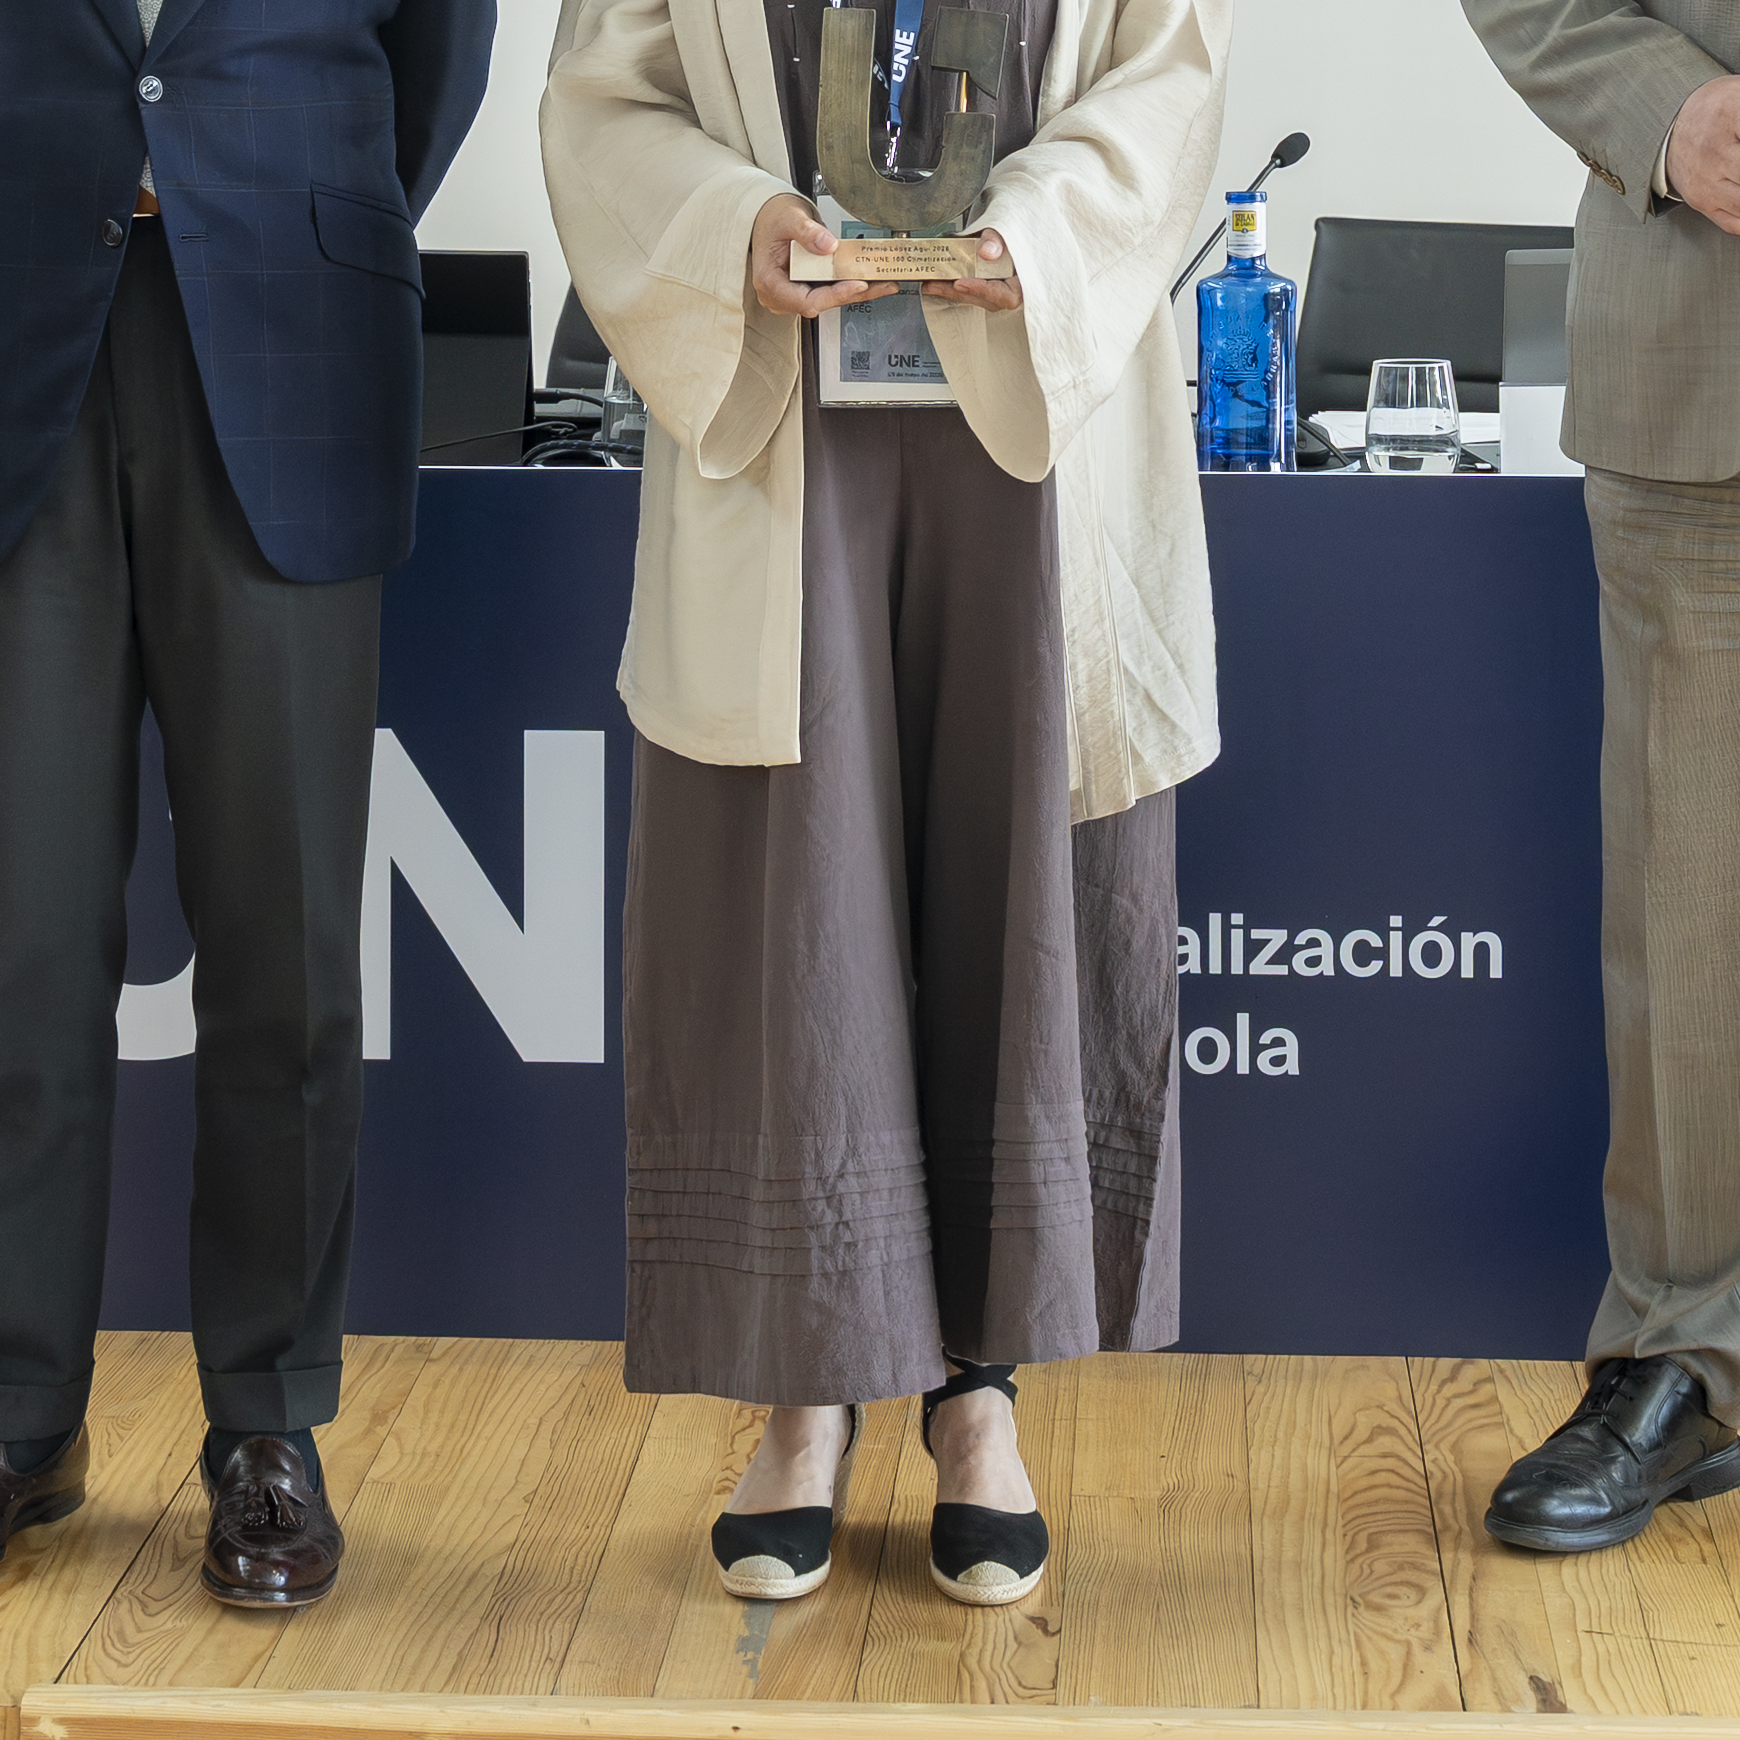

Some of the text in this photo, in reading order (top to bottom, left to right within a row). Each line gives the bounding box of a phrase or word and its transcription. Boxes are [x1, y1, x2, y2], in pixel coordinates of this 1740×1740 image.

[891, 28, 915, 83] UNE
[846, 304, 872, 313] AFEC
[887, 354, 921, 368] UNE
[1178, 912, 1503, 979] alización
